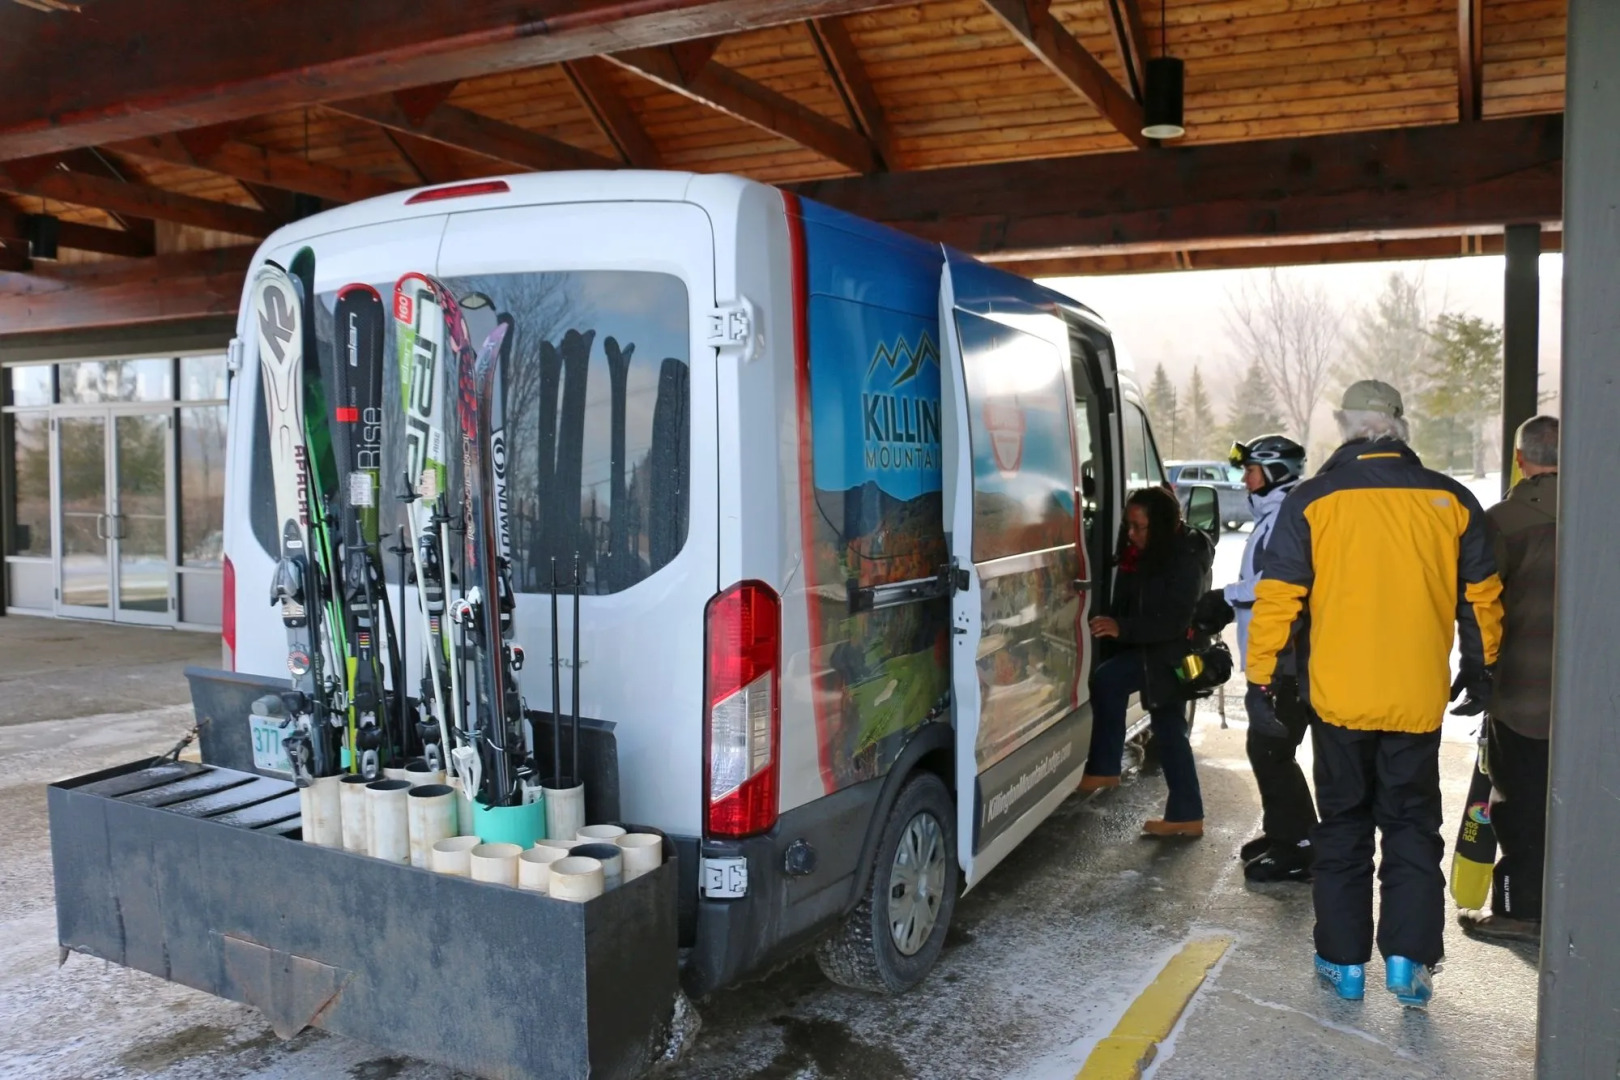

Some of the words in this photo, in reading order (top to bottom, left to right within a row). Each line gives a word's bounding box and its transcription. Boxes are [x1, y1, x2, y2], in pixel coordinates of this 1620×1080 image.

[398, 296, 410, 321] 160
[348, 312, 358, 367] elan
[294, 445, 308, 526] APACHE
[253, 726, 279, 755] 377
